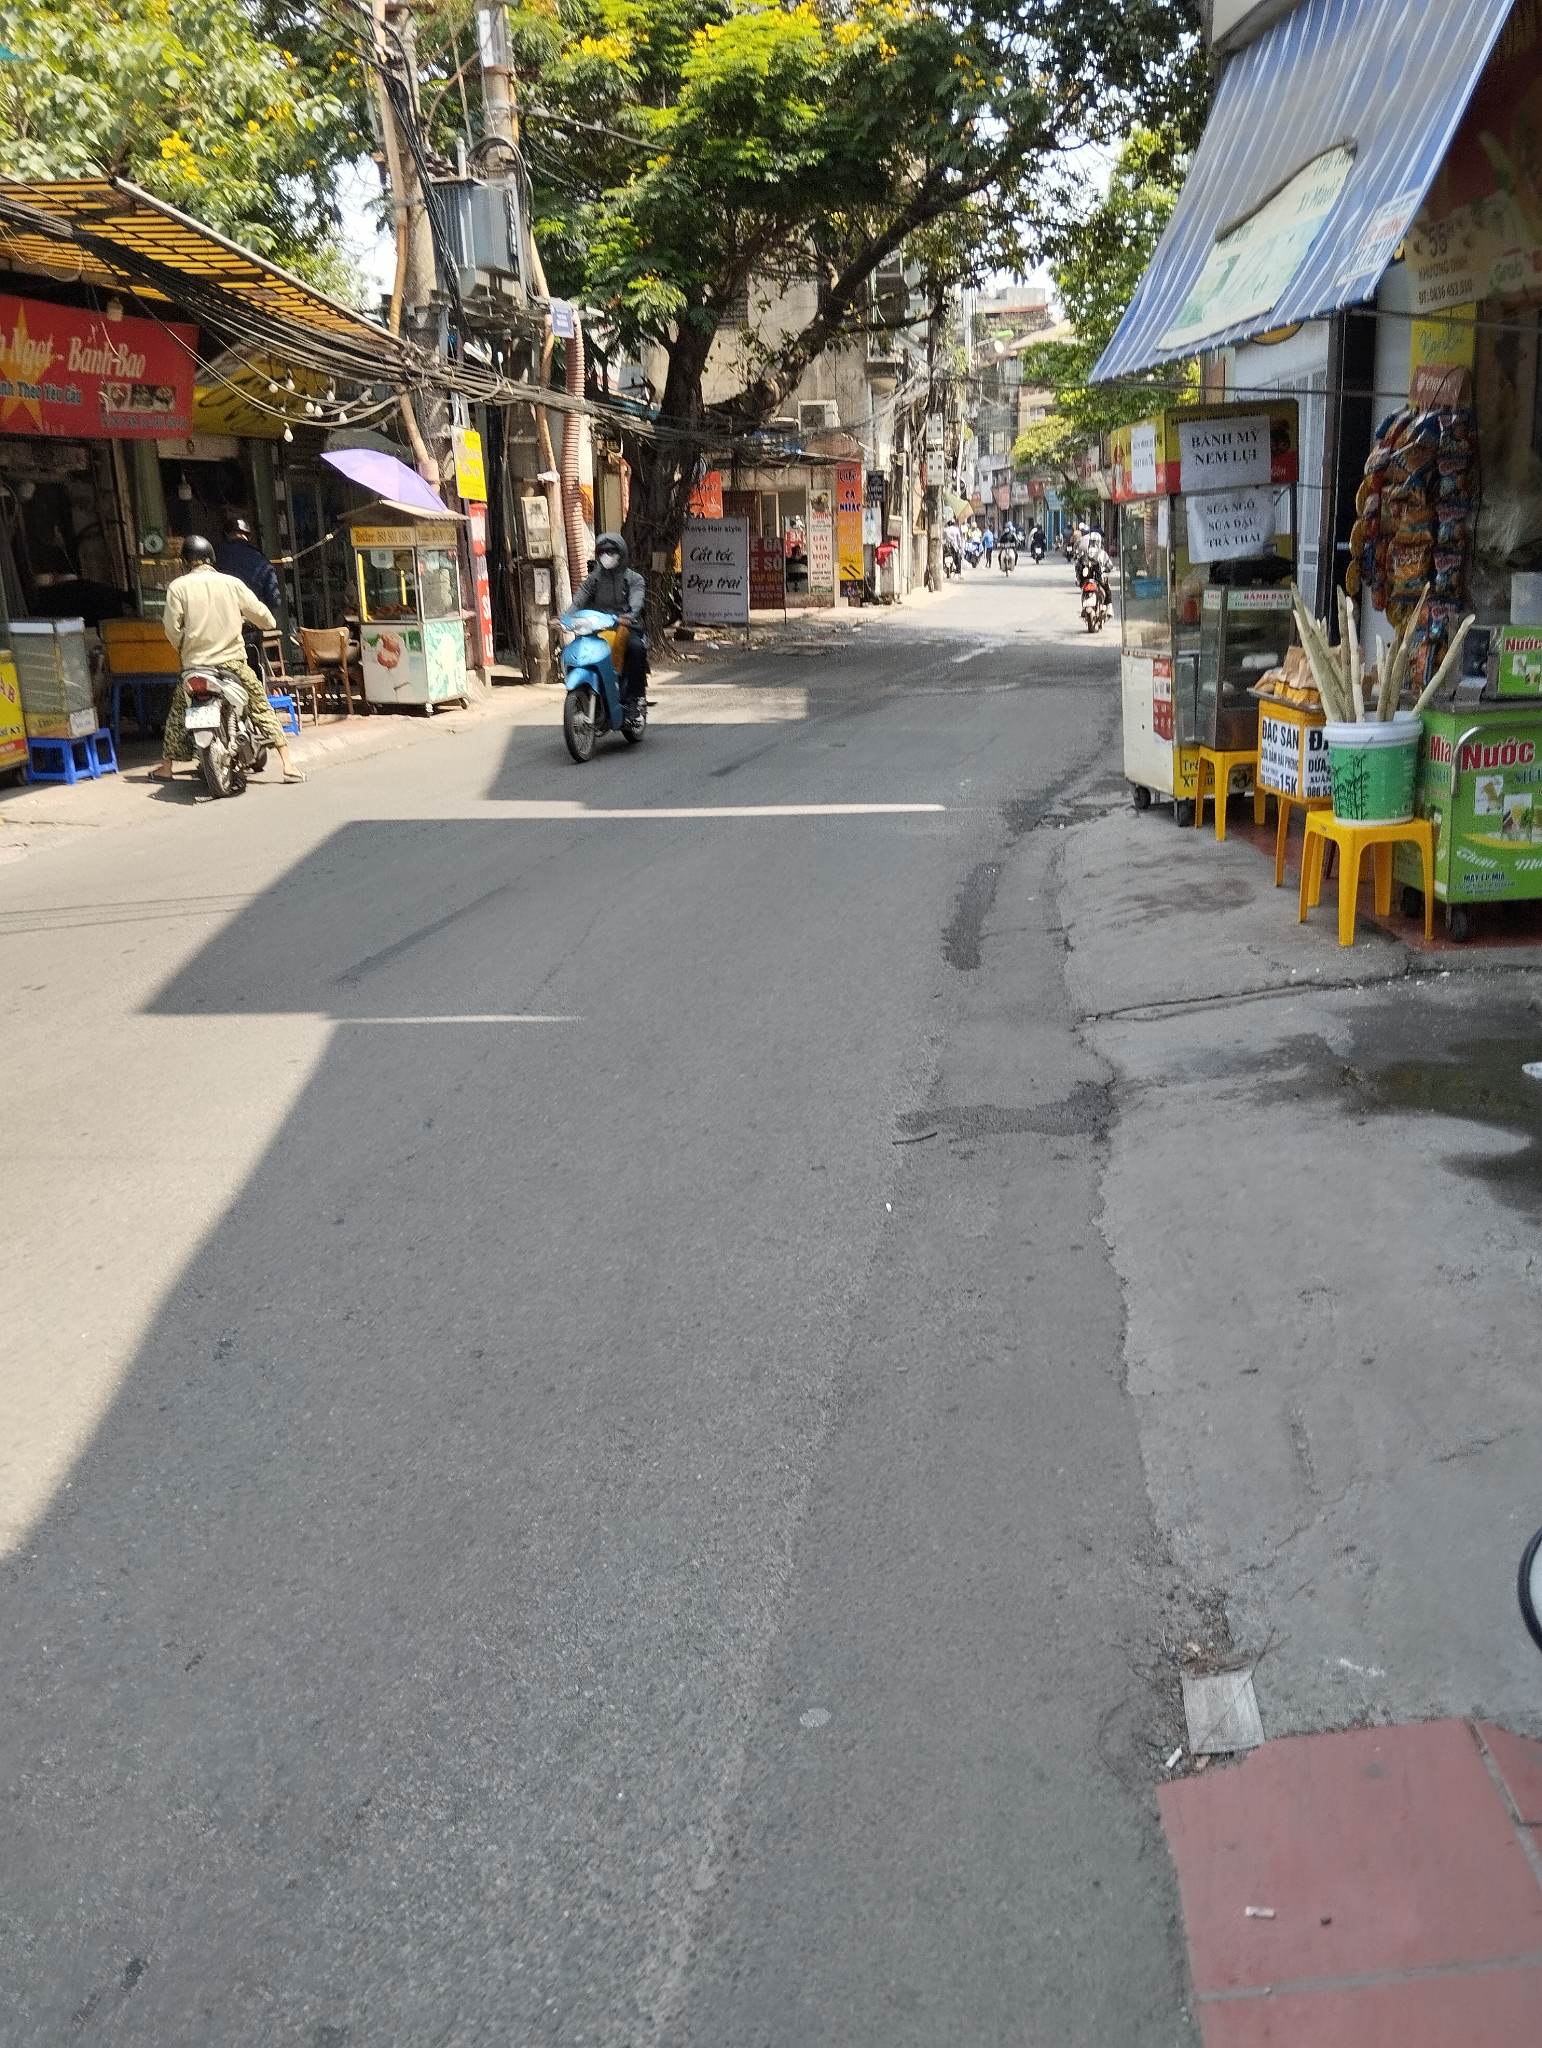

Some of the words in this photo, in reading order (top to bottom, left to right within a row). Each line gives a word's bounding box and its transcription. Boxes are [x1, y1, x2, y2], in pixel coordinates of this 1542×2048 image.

[1195, 451, 1228, 465] NEM
[690, 547, 713, 562] Cắt
[715, 548, 735, 562] tóc
[687, 574, 713, 594] Đẹp
[716, 576, 743, 590] trai
[1429, 735, 1452, 763] Mía
[1461, 736, 1535, 771] Nước
[1280, 773, 1298, 798] 15K
